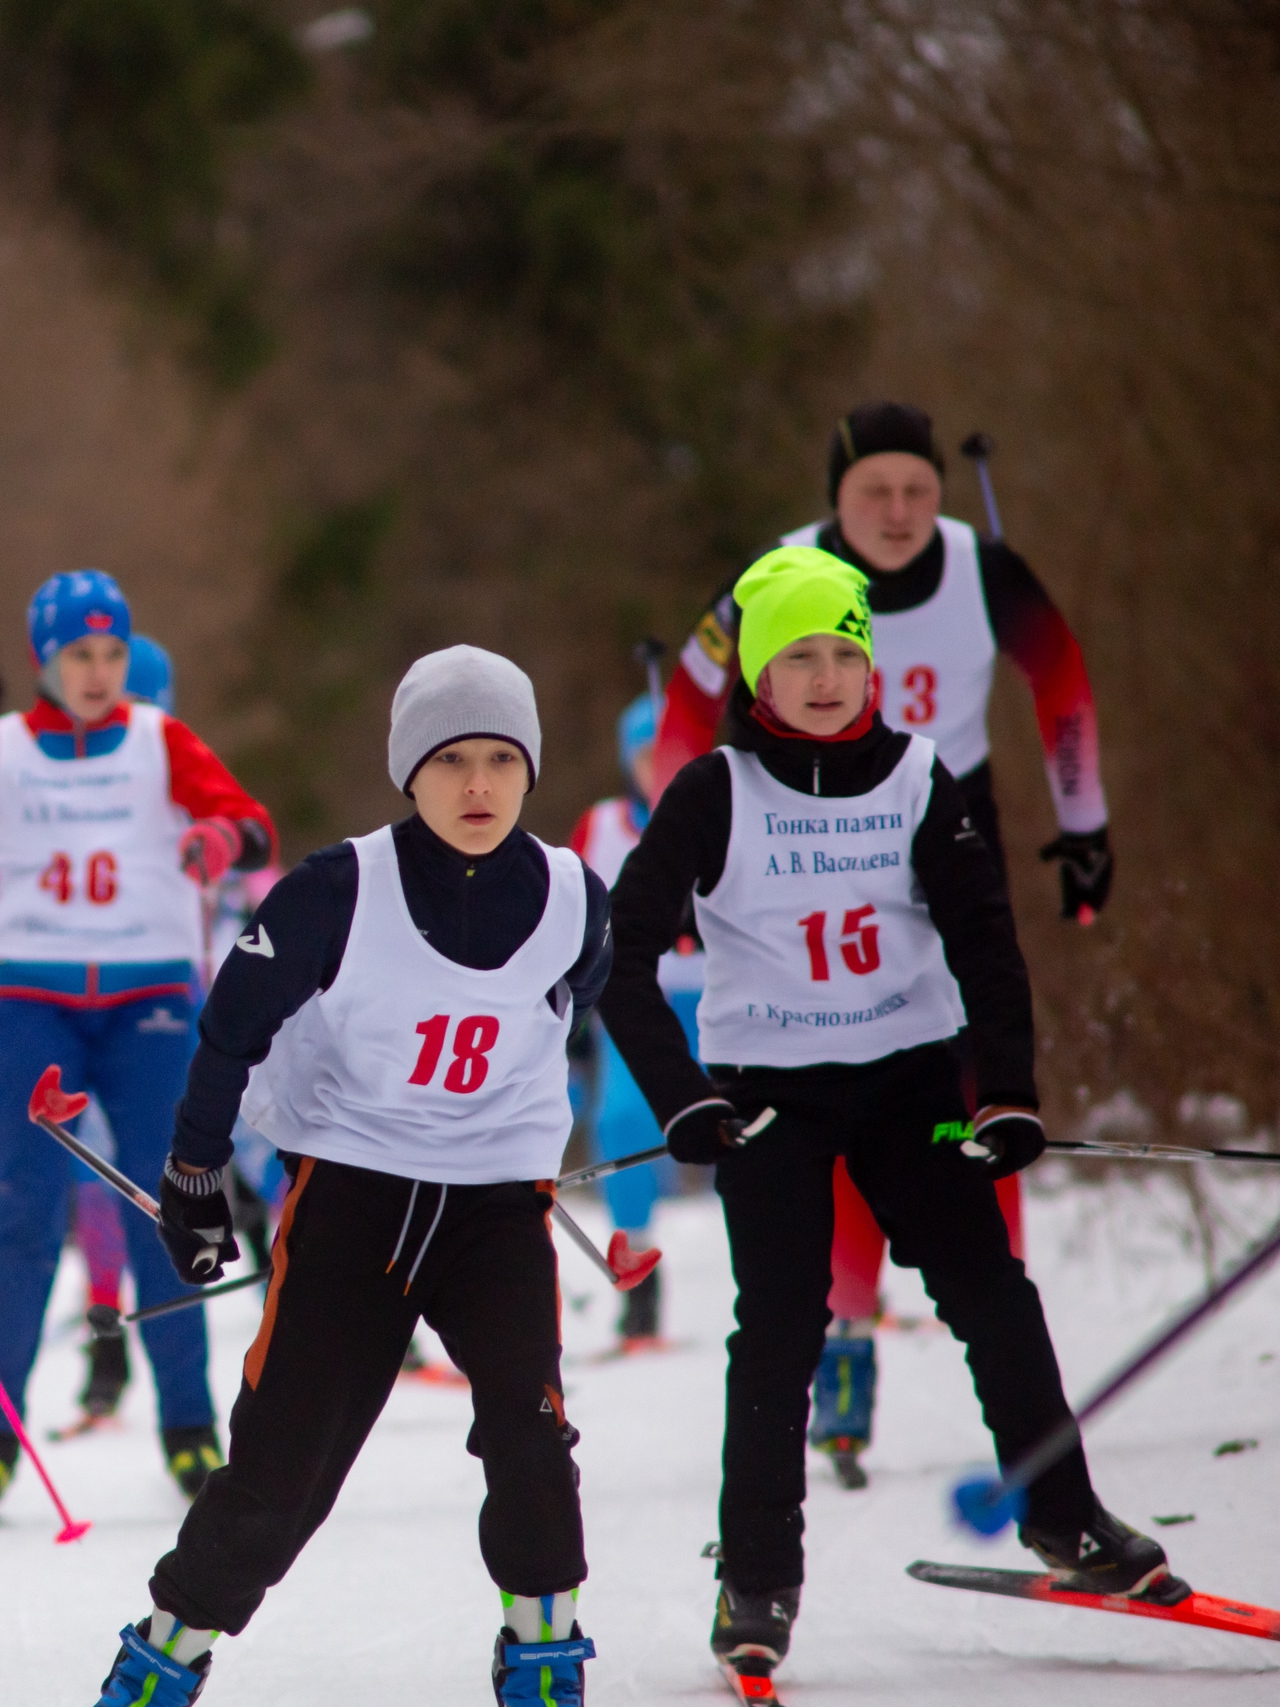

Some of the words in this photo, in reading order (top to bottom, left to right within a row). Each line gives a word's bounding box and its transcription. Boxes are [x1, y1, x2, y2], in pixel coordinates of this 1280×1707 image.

[764, 812, 829, 835] Гонка
[834, 812, 903, 834] паяти
[39, 850, 119, 907] 46
[798, 903, 881, 982] 15
[407, 1013, 500, 1094] 18
[127, 1636, 182, 1679] SPINE
[520, 1647, 584, 1660] SPINE
